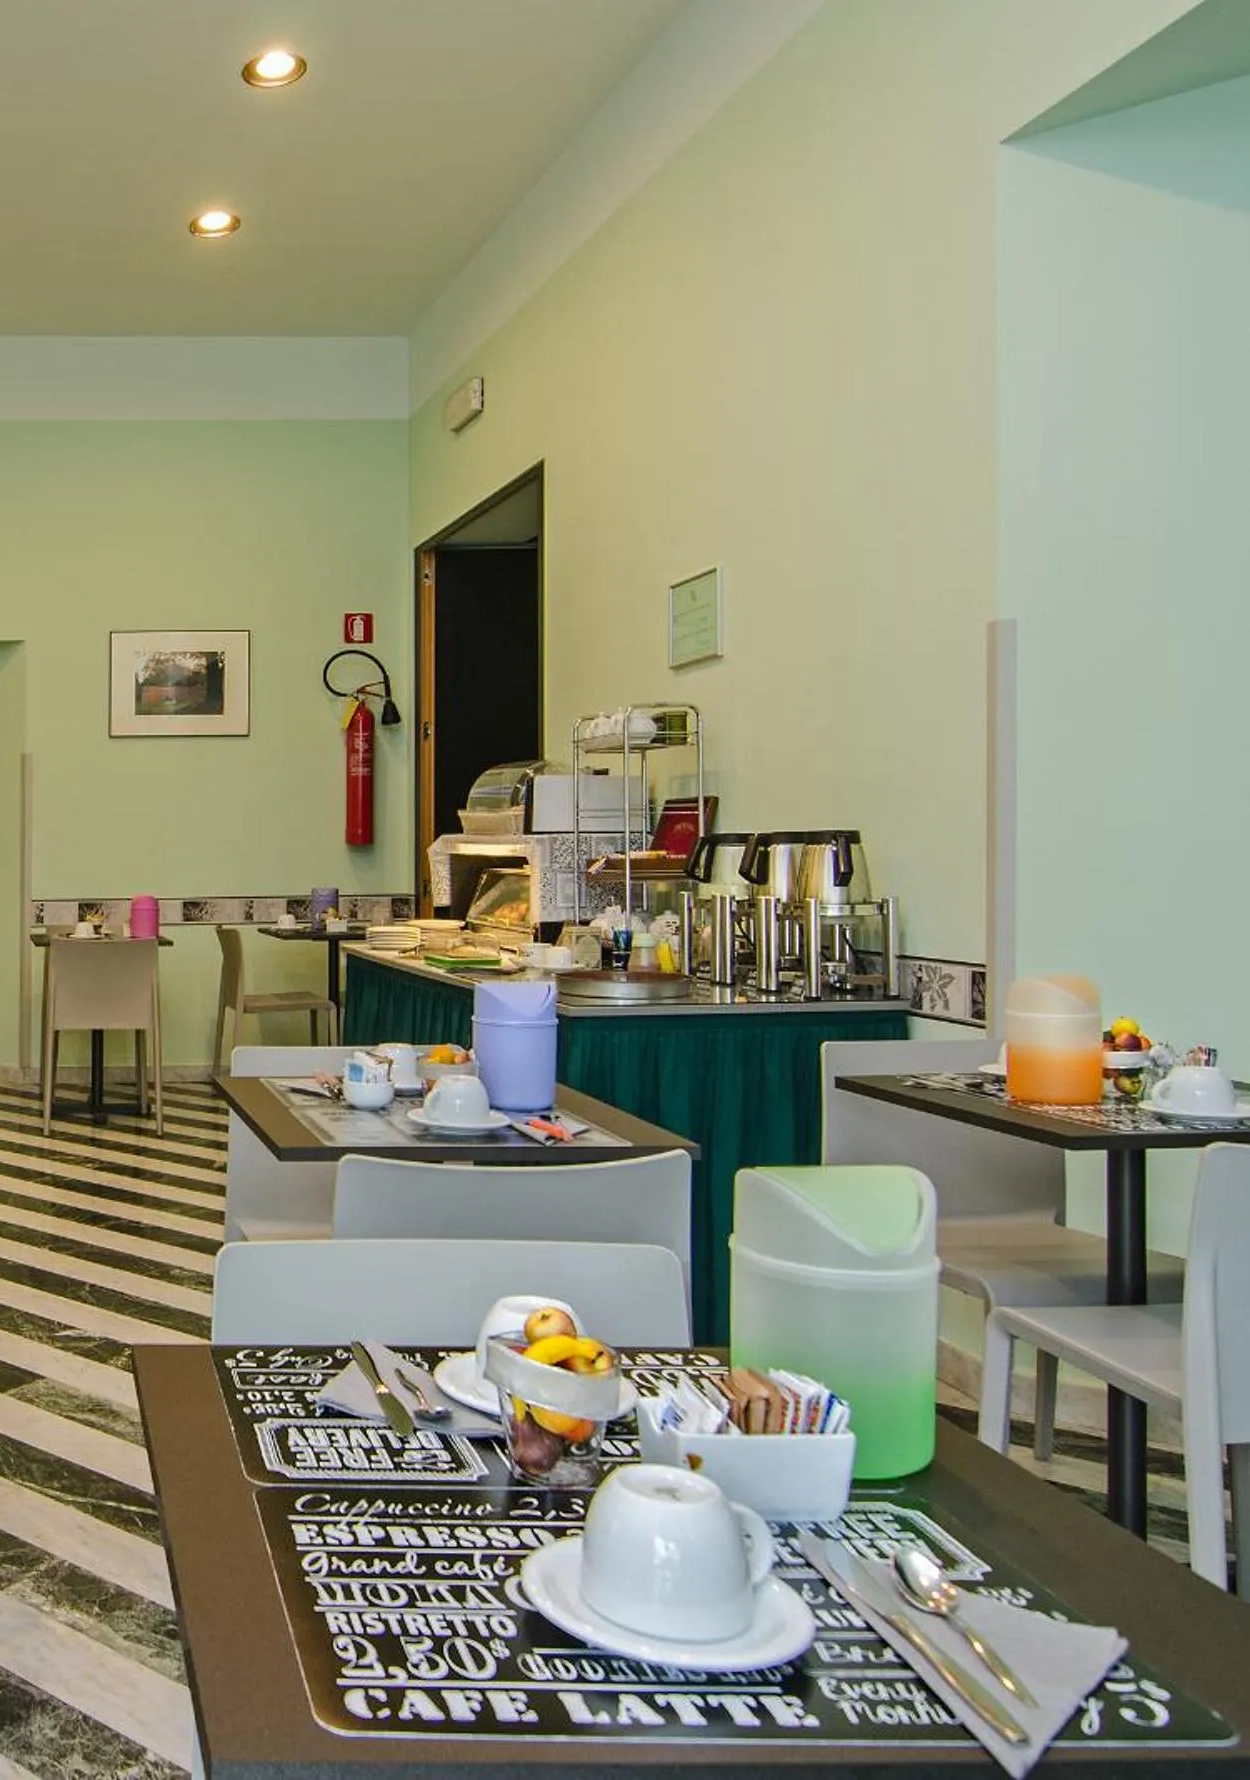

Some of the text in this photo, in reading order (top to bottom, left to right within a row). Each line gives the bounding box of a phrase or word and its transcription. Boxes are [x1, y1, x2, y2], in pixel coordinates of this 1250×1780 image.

[287, 1427, 445, 1449] DELIVERY
[296, 1447, 394, 1469] FREE
[294, 1493, 496, 1527] Cappuccino
[291, 1523, 558, 1549] ESPRESSO
[434, 1550, 515, 1580] café
[325, 1612, 518, 1637] RISTRETTO
[343, 1690, 821, 1728] CAFE LATTE
